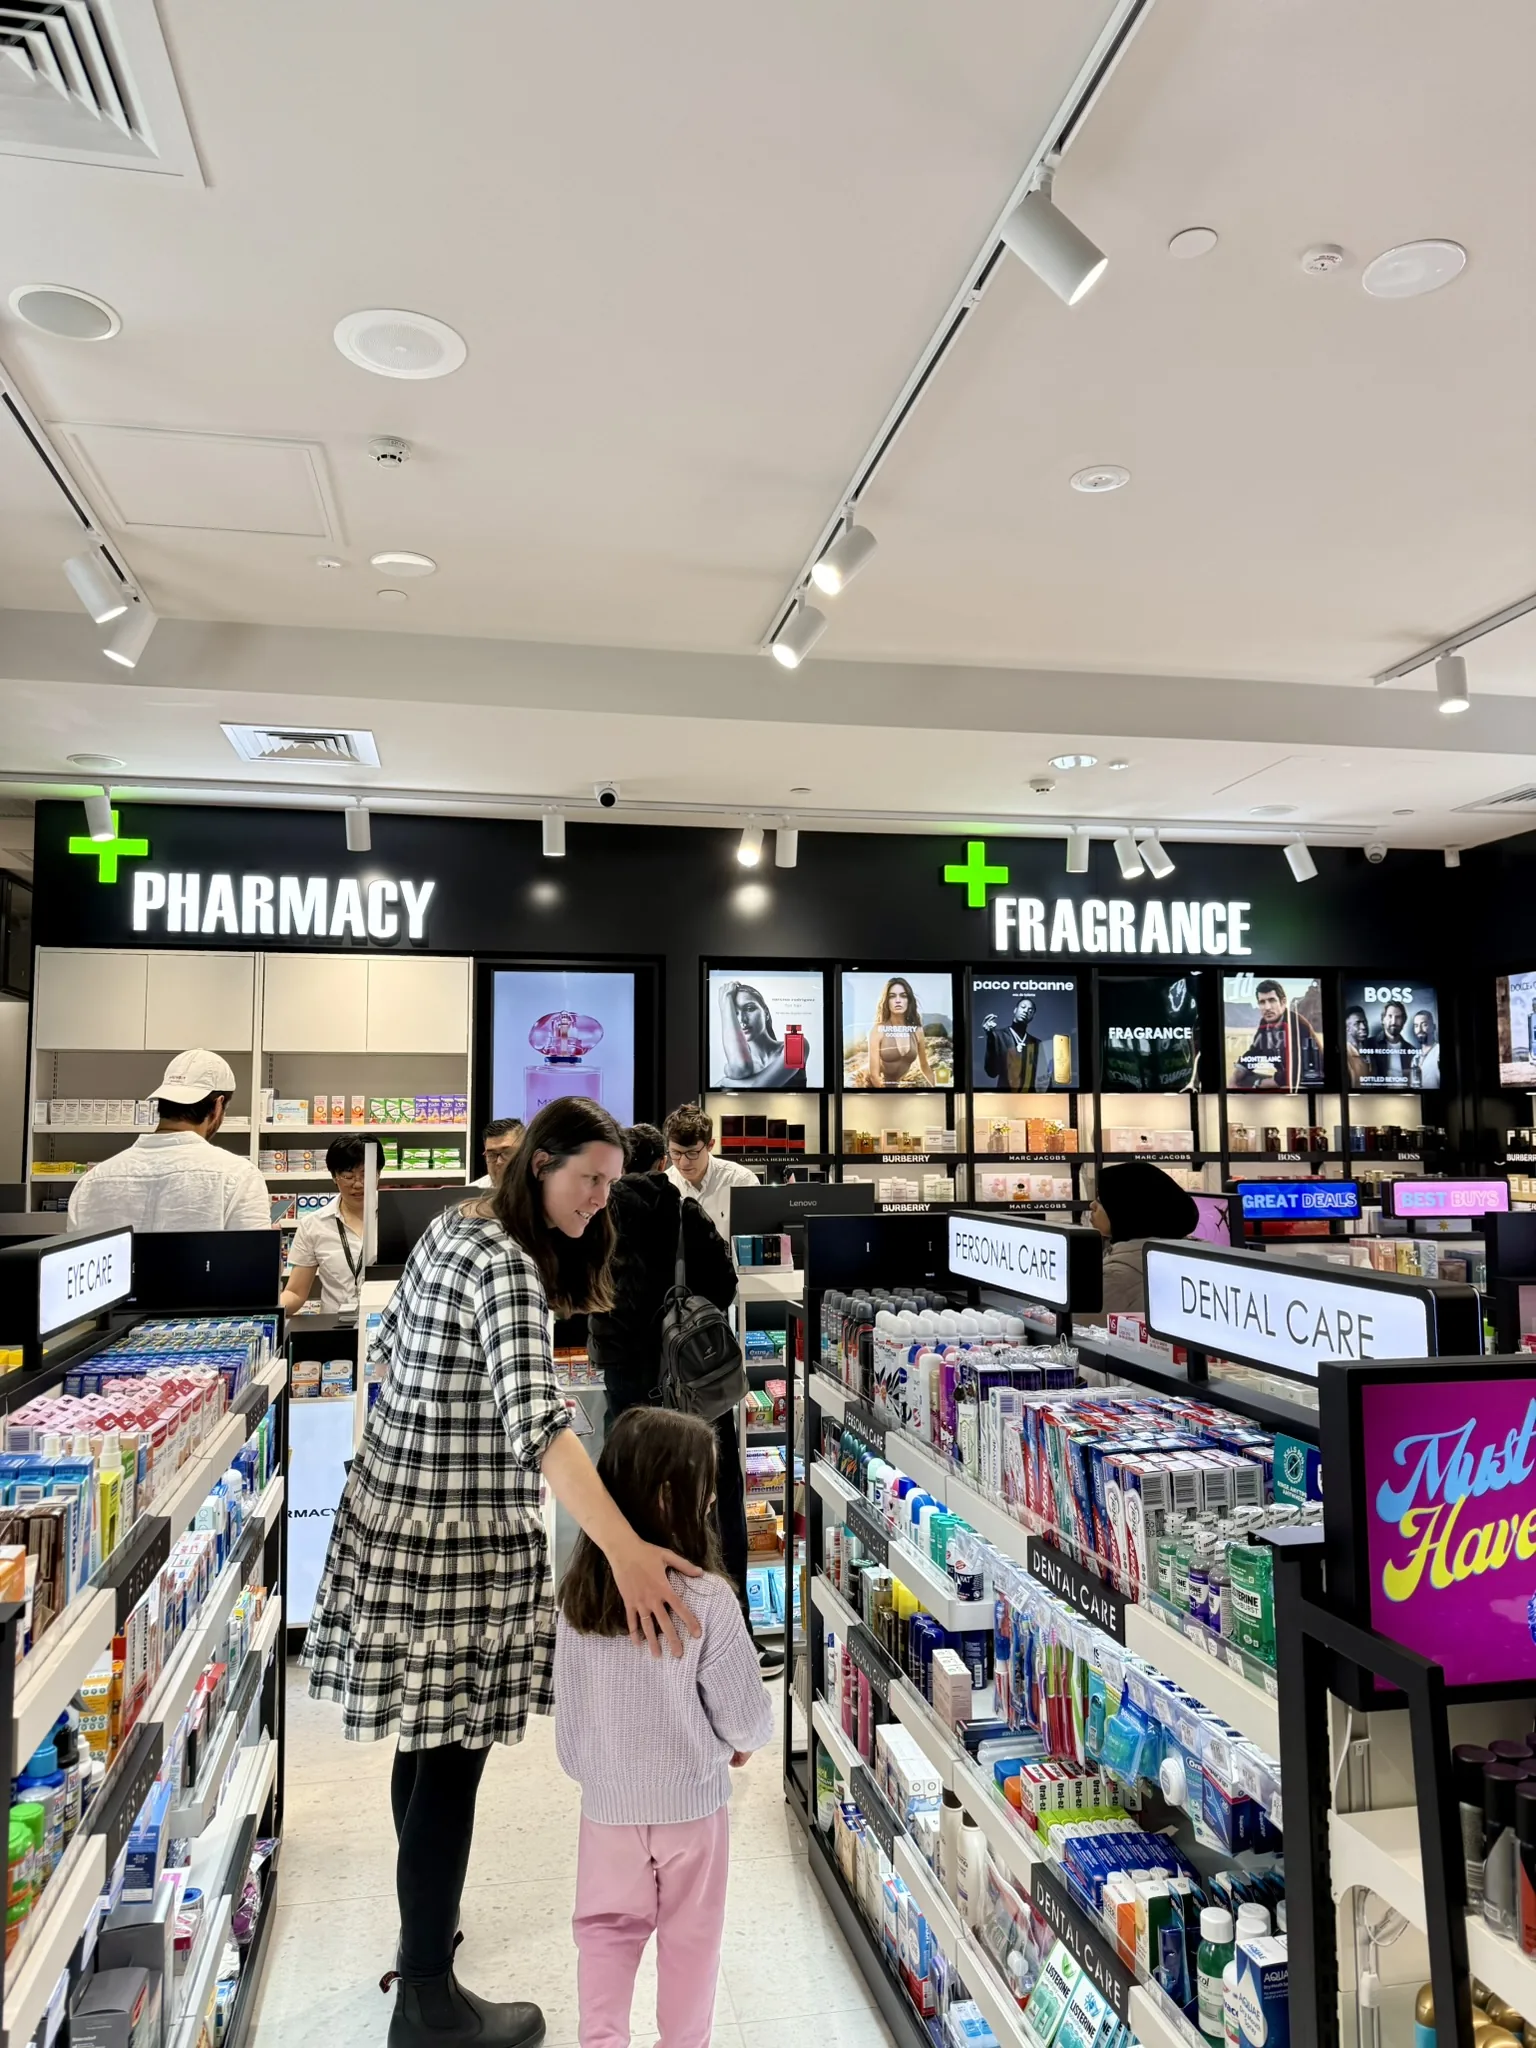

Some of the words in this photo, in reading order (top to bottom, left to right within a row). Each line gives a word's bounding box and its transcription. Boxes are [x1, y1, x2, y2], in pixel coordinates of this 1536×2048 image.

[133, 871, 435, 938] PHARMACY
[995, 897, 1252, 955] FRAGRANCE
[973, 980, 1010, 992] paco
[1013, 979, 1074, 991] rabanne
[1364, 986, 1413, 1003] BOSS
[878, 1025, 918, 1033] BURBERRY
[1108, 1027, 1193, 1040] FRAGRANCE
[882, 1154, 930, 1163] BURBERRY
[1278, 1153, 1301, 1161] BOSS
[1398, 1152, 1420, 1160] BOSS
[789, 1199, 817, 1207] Lenovo
[882, 1203, 930, 1212] BURBERRY
[1243, 1194, 1299, 1209] GREAT
[1302, 1192, 1357, 1208] DEALS
[1401, 1191, 1447, 1208] BEST
[1451, 1190, 1500, 1207] BUYS
[67, 1262, 85, 1299] EYE
[87, 1254, 112, 1291] CARE
[956, 1232, 1014, 1271] PERSONAL
[1018, 1244, 1056, 1281] CARE
[1181, 1276, 1276, 1337] DENTAL
[1286, 1299, 1374, 1360] CARE
[846, 1411, 869, 1440] PERSONAL
[869, 1428, 883, 1451] CARE
[1376, 1398, 1536, 1523] Must
[849, 1512, 872, 1547] PERSONAL
[872, 1534, 887, 1561] CARE
[1382, 1493, 1536, 1602] Have
[1033, 1549, 1077, 1602] DENTAL
[1080, 1584, 1116, 1632] CARE
[849, 1639, 872, 1679] PERSONAL
[872, 1665, 888, 1699] CARE
[1036, 1880, 1081, 1957] DENTAL
[1083, 1943, 1121, 2010] CARE
[1045, 1961, 1072, 2000] LISTERINE
[1069, 1998, 1097, 2040] LISTERINE
